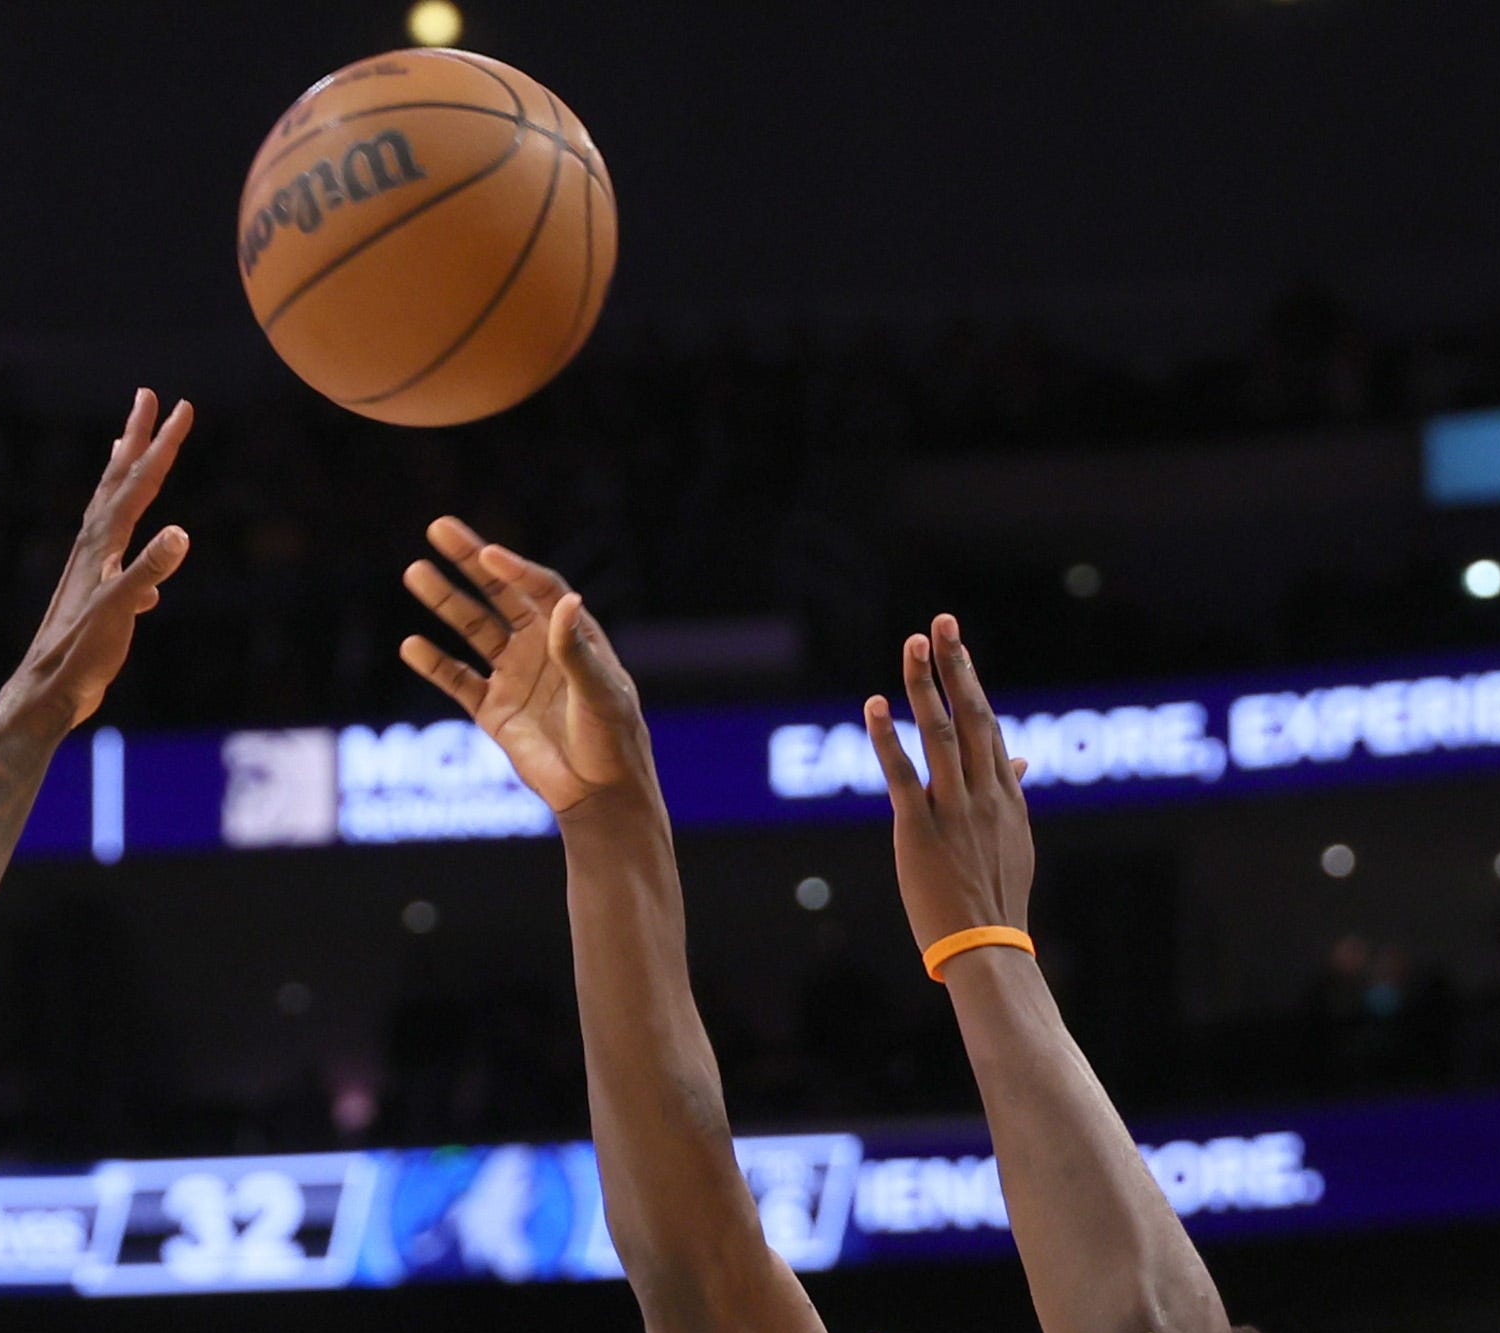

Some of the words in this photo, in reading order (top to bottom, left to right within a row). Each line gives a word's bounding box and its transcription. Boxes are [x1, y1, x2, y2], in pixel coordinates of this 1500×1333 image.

[768, 720, 932, 799] EA
[1143, 1130, 1325, 1214] ORE.
[160, 1170, 308, 1284] 32
